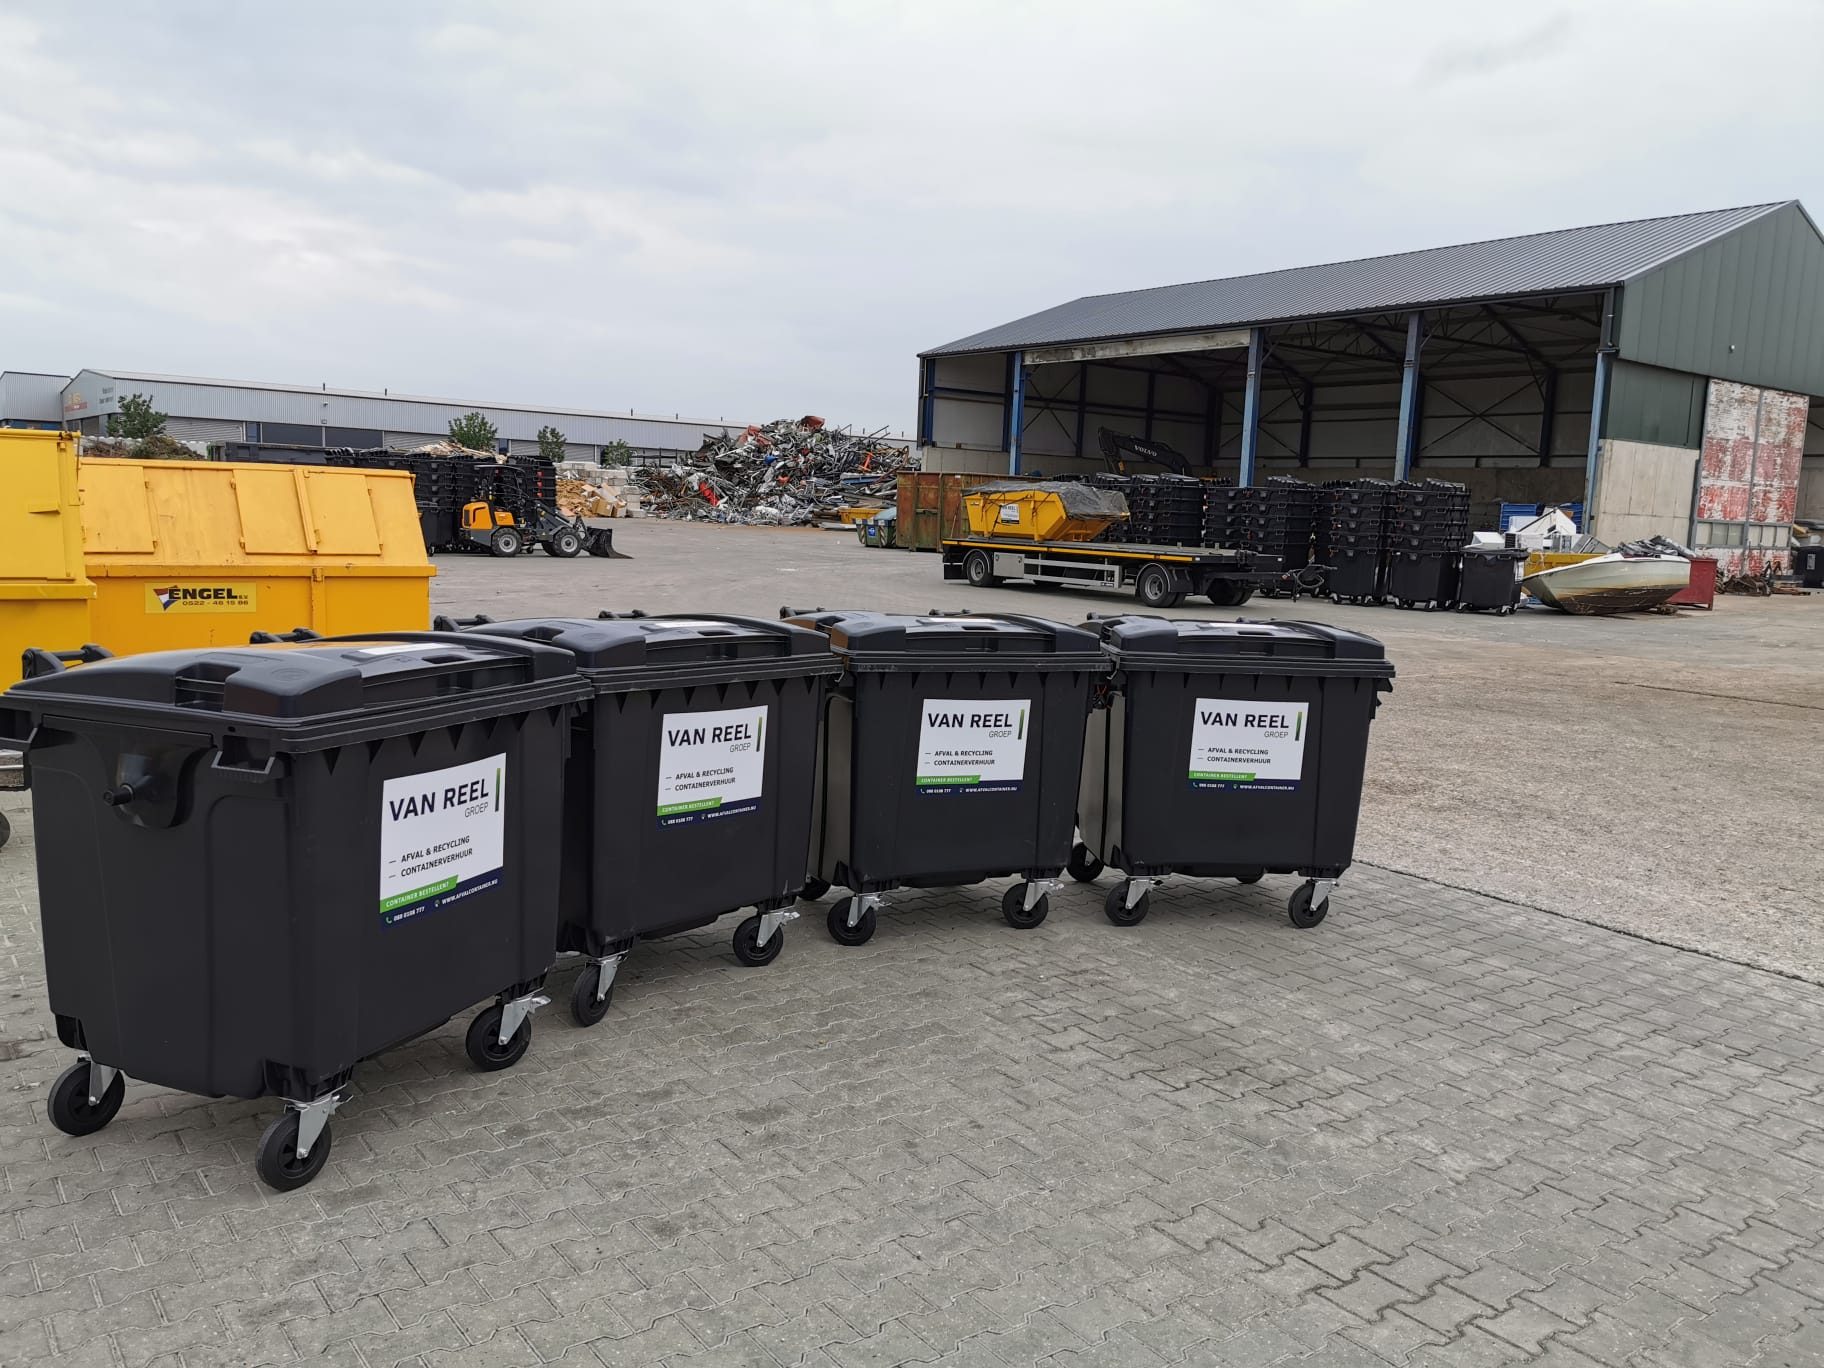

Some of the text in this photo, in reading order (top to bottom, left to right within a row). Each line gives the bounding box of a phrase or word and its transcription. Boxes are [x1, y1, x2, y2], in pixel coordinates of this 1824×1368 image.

[1134, 444, 1158, 457] VOLVO
[168, 588, 238, 600] ENGEL
[928, 713, 1012, 728] VAN REEL
[1200, 712, 1289, 728] VAN REEL
[668, 723, 752, 747] VAN REEL
[730, 742, 751, 752] GROEP
[675, 772, 694, 780] AFVAL
[702, 767, 734, 777] RECYCLING
[675, 777, 736, 791] CONTAINERVERHUUR
[389, 779, 489, 821] VAN REEL
[464, 802, 488, 818] GROEP
[662, 804, 688, 813] CONTAINER
[401, 836, 470, 863] AFVAL & RECYCLING
[401, 848, 472, 877] CONTAINERVERHUUR
[386, 892, 417, 907] CONTAINER
